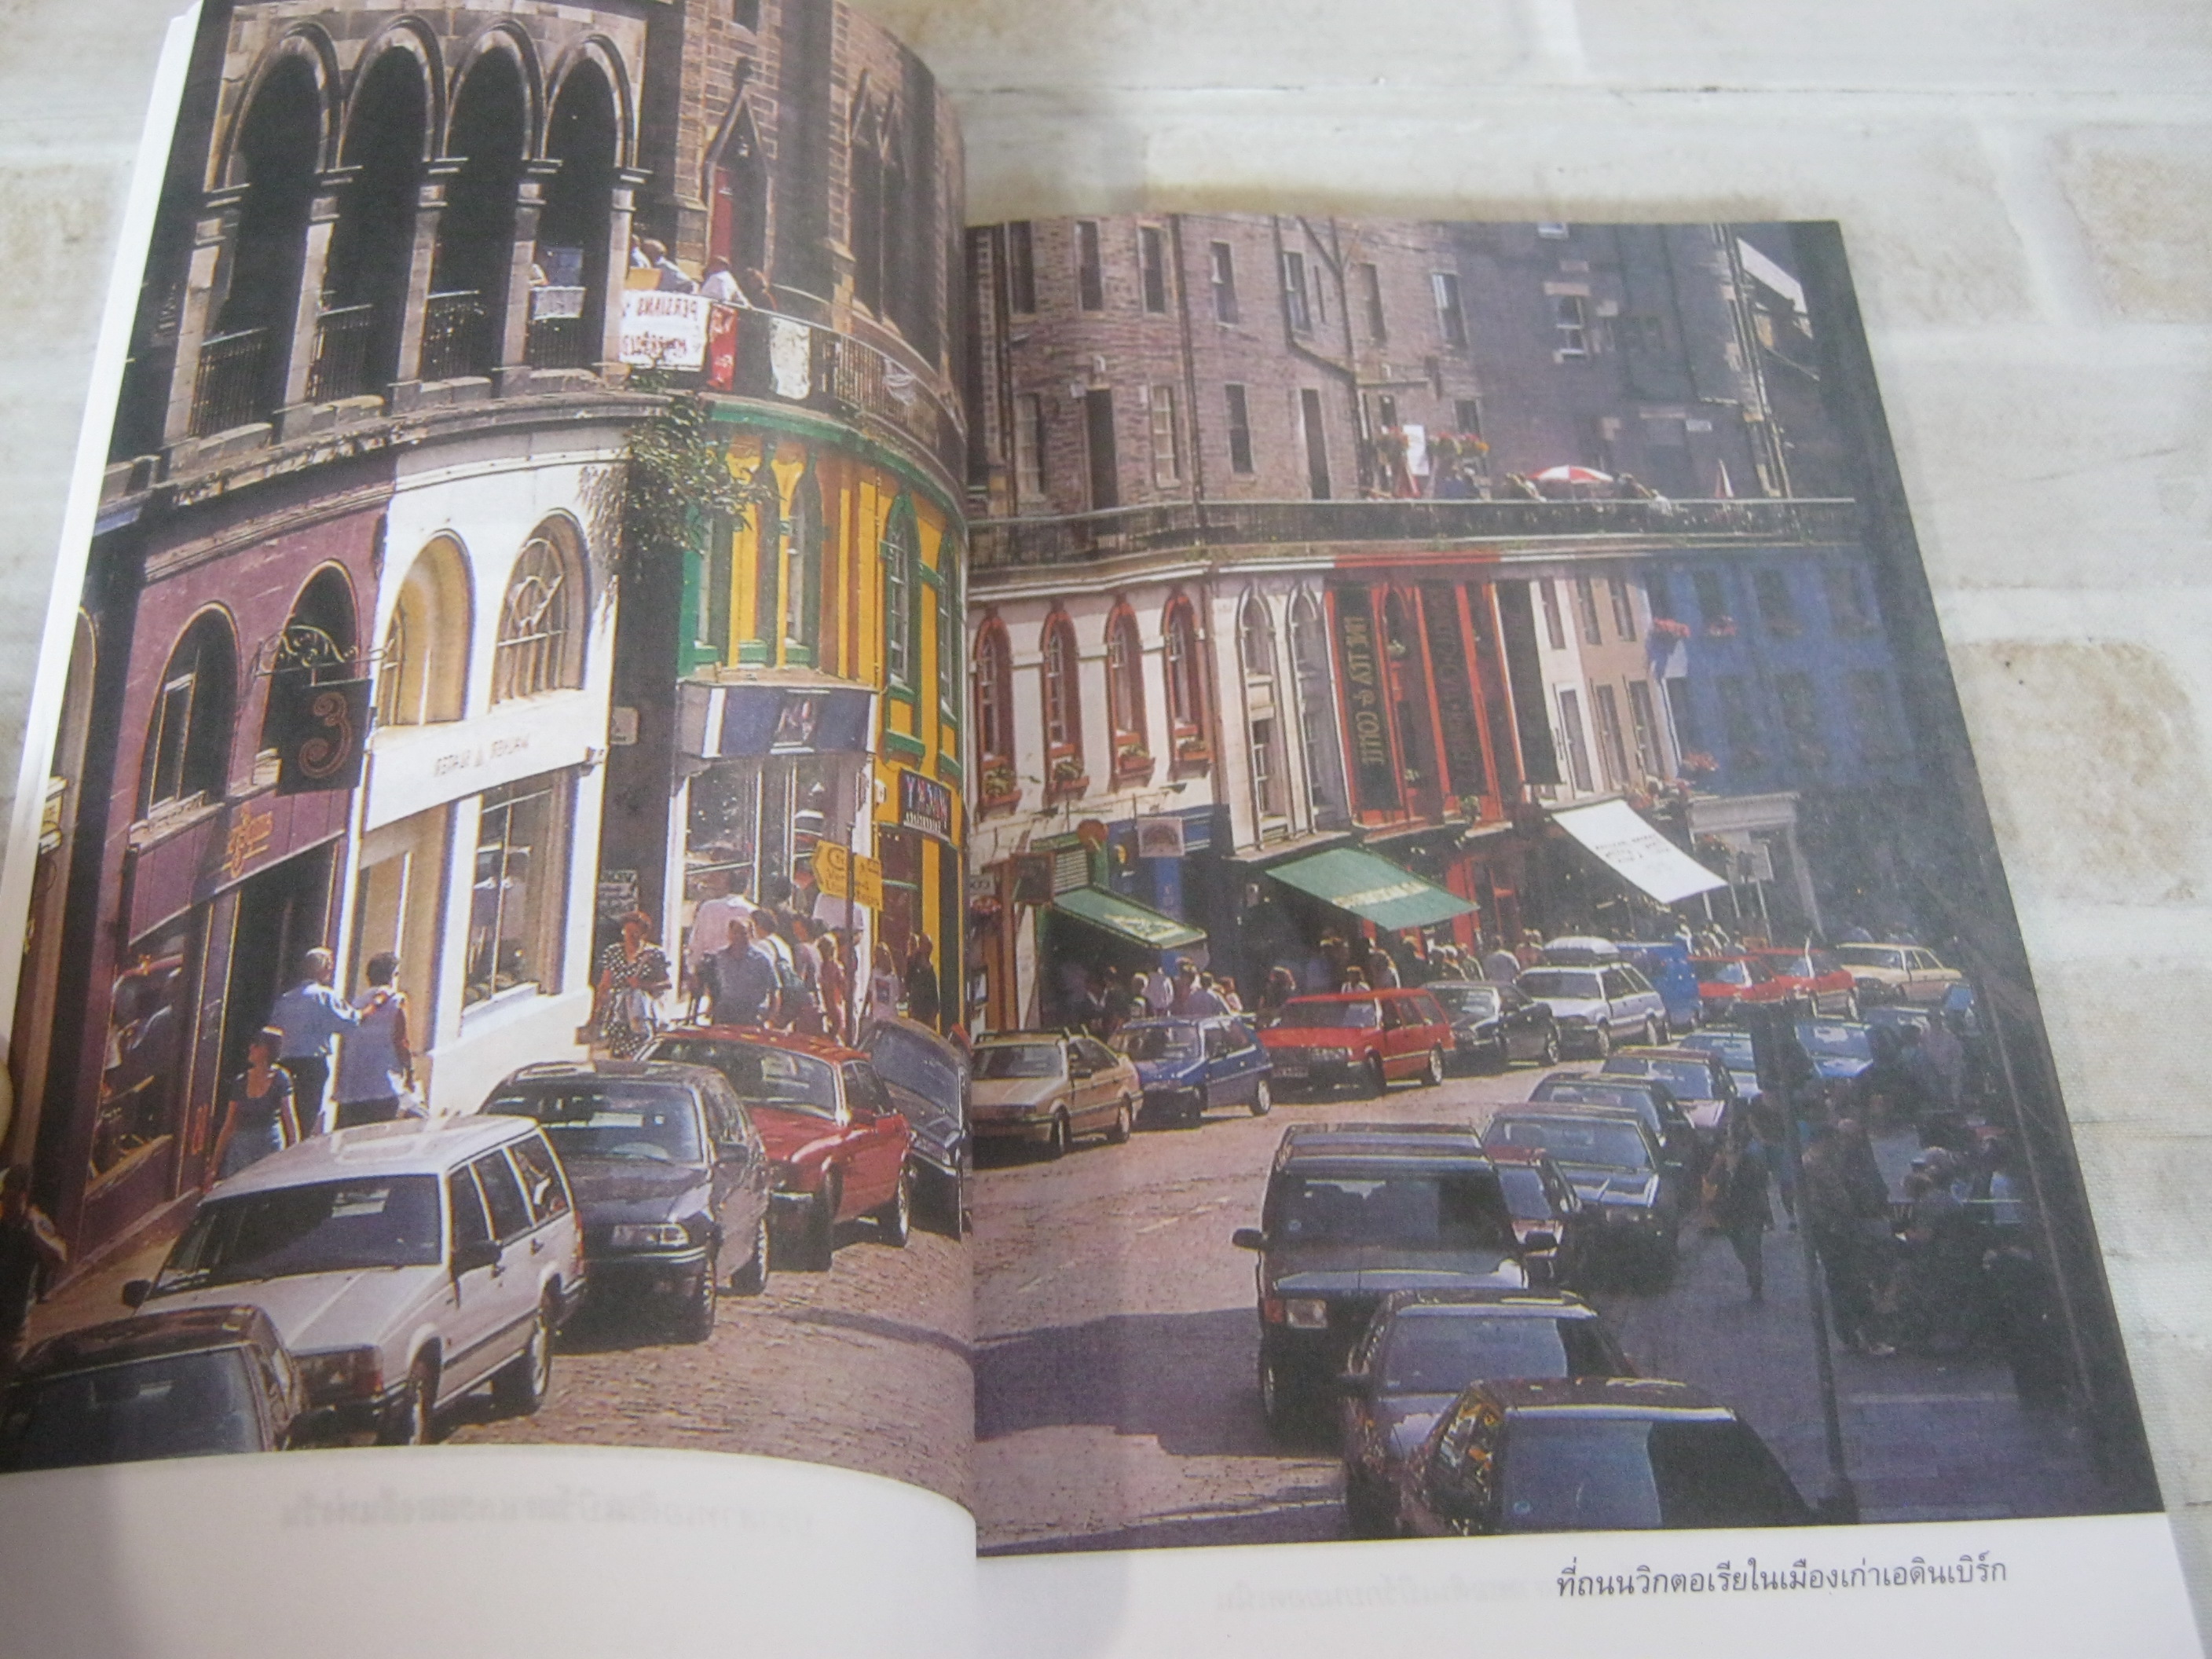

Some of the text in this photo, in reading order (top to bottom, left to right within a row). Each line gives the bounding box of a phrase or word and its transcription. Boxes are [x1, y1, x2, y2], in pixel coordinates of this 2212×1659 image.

[1556, 1551, 2007, 1598] ที่ถนนวิกตอเรียในเมืองเก่าเอดินเบิร์ก
